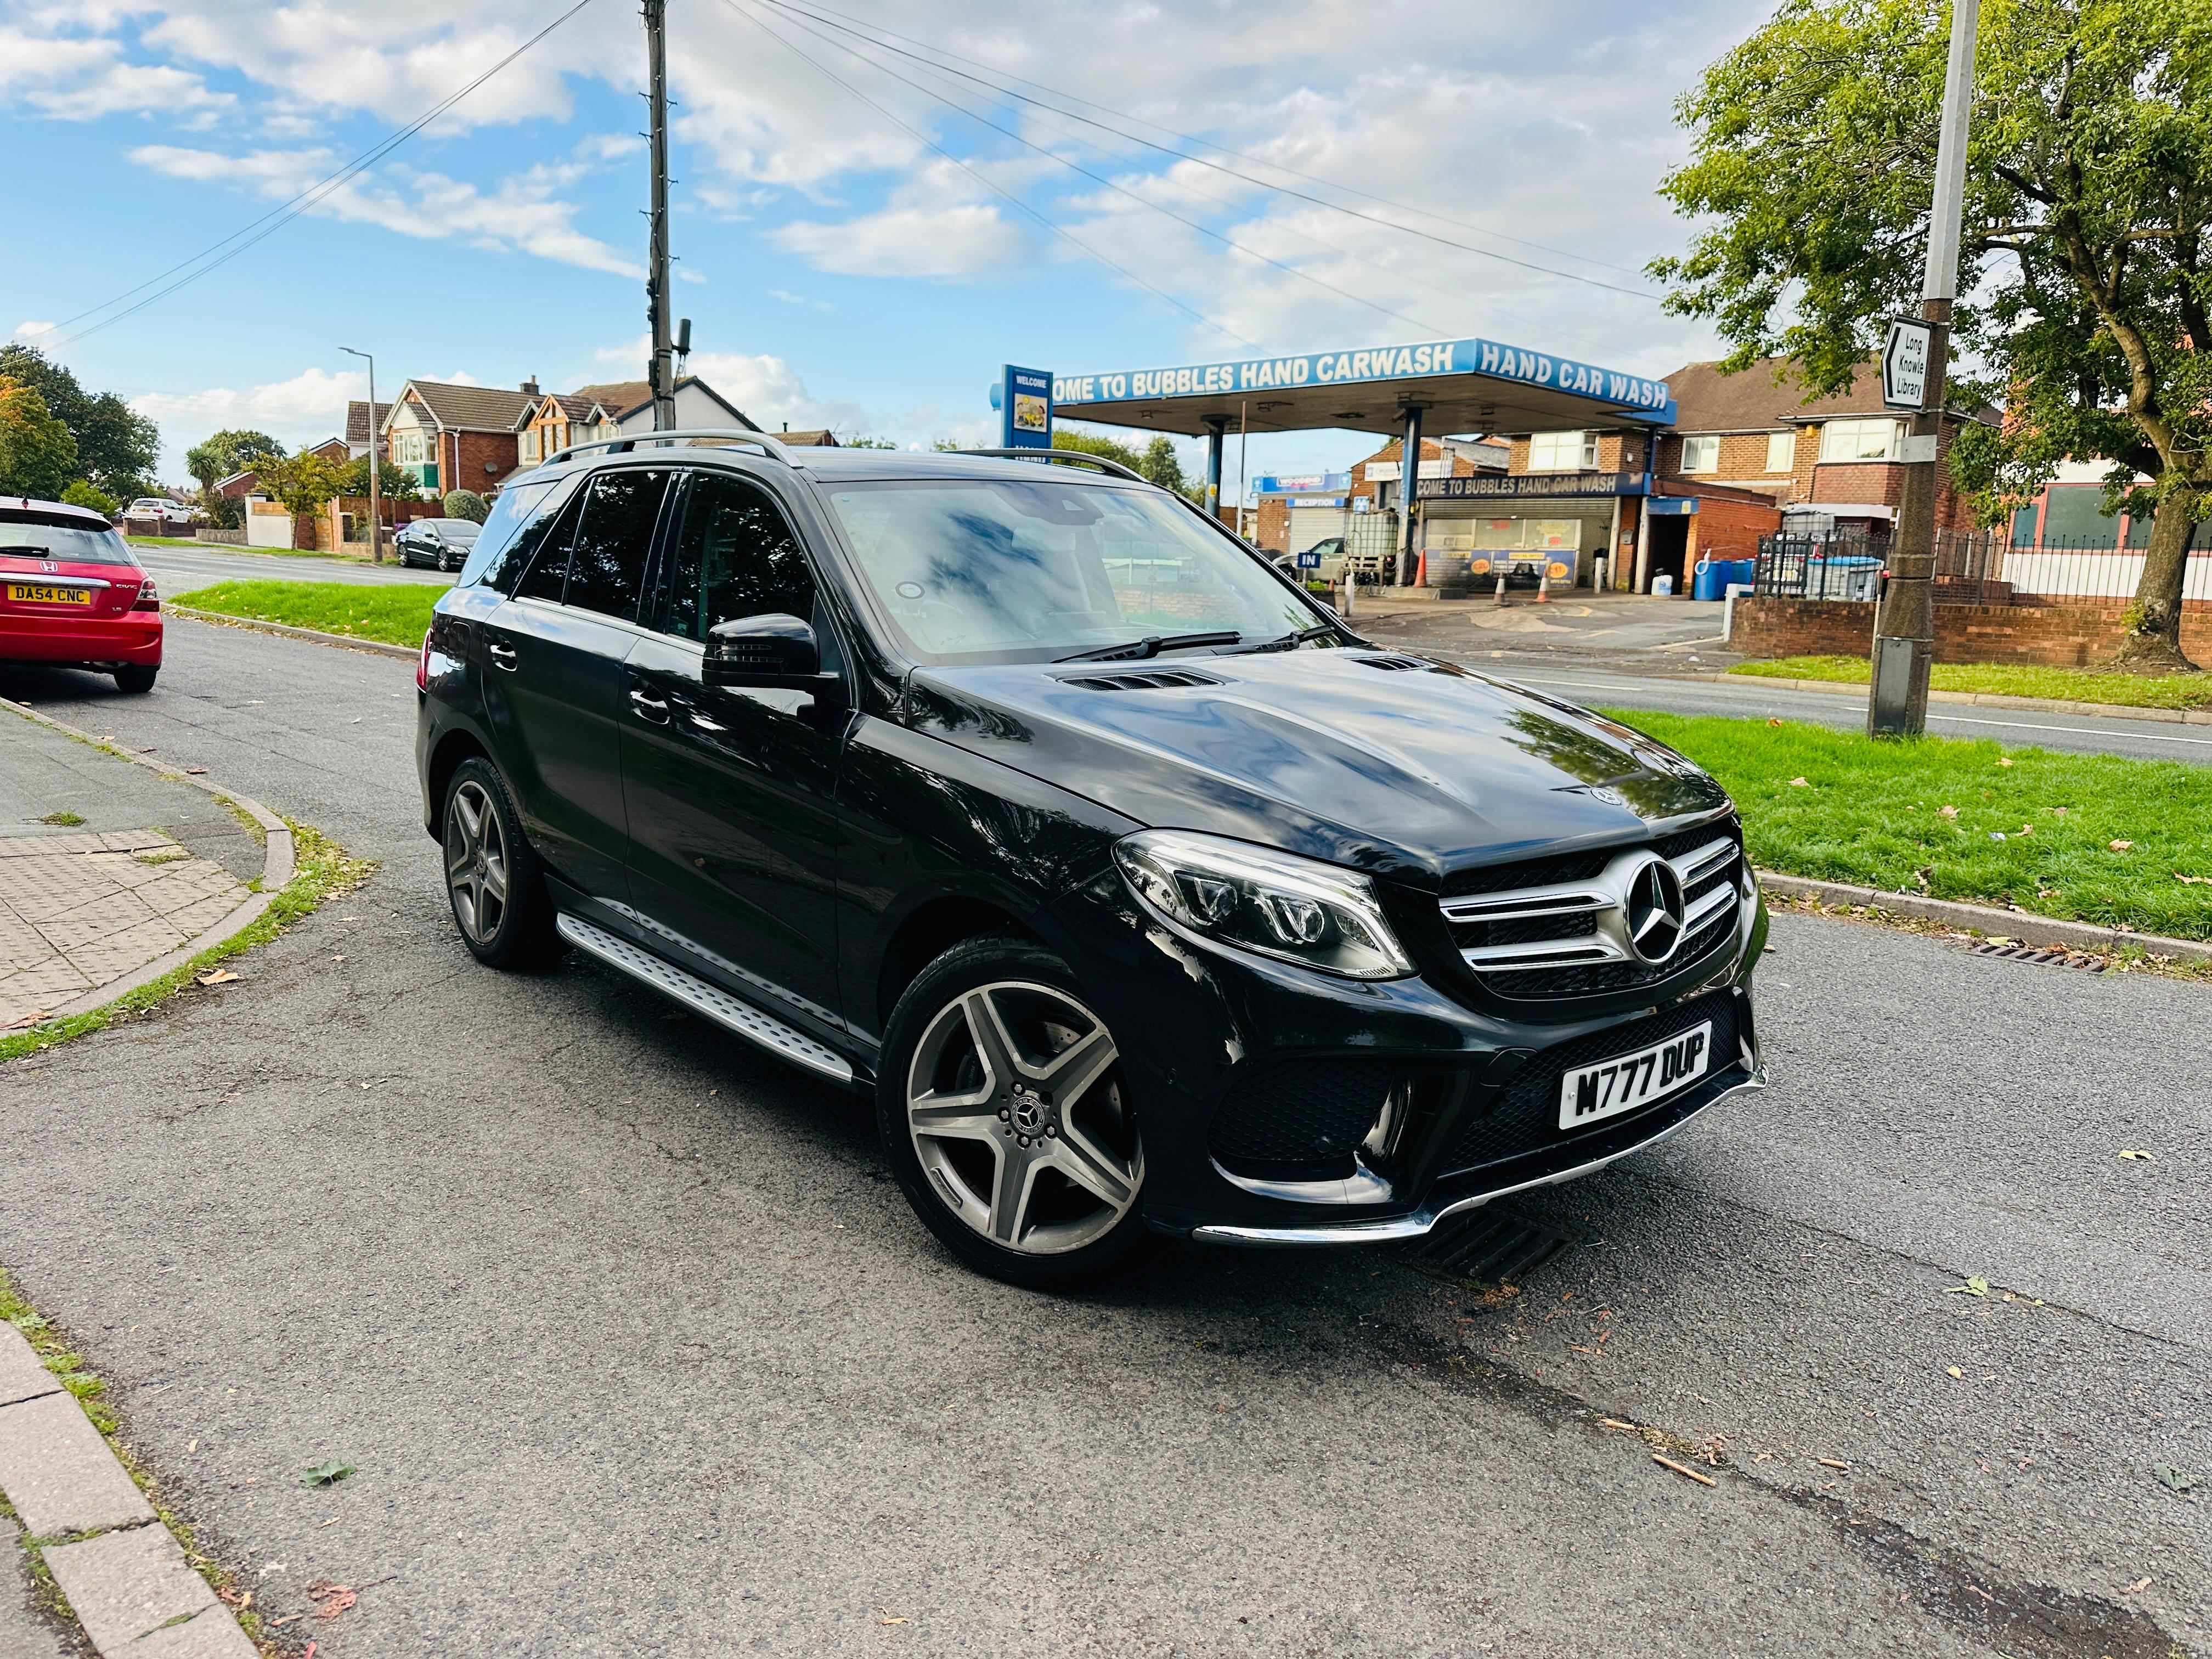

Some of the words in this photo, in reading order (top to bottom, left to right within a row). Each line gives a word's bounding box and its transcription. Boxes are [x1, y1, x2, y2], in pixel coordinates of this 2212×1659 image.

[1905, 332, 1923, 355] Long
[1053, 377, 1095, 402] OME
[1099, 375, 1126, 399] TO
[1132, 365, 1234, 396] BUBBLES
[1240, 359, 1309, 388] HAND
[1316, 344, 1455, 381] CARWASH
[1899, 354, 1924, 375] Knowle
[1016, 375, 1047, 388] WELCOME
[1480, 343, 1552, 383] HAND
[1559, 363, 1603, 396] CAR
[1609, 374, 1667, 409] WASH
[1897, 377, 1921, 399] Library
[1396, 480, 1446, 495] COME
[1448, 479, 1463, 494] TO
[1465, 478, 1516, 494] BUBBLES
[1517, 478, 1550, 493] HAND
[1553, 477, 1578, 493] CAR
[1581, 476, 1616, 492] WASH
[1294, 498, 1335, 507] RECEPTION
[1302, 555, 1316, 565] IN
[16, 586, 53, 600] DA54
[57, 589, 84, 602] CNC
[1575, 1052, 1657, 1116] M777
[1660, 1031, 1705, 1088] DUP
